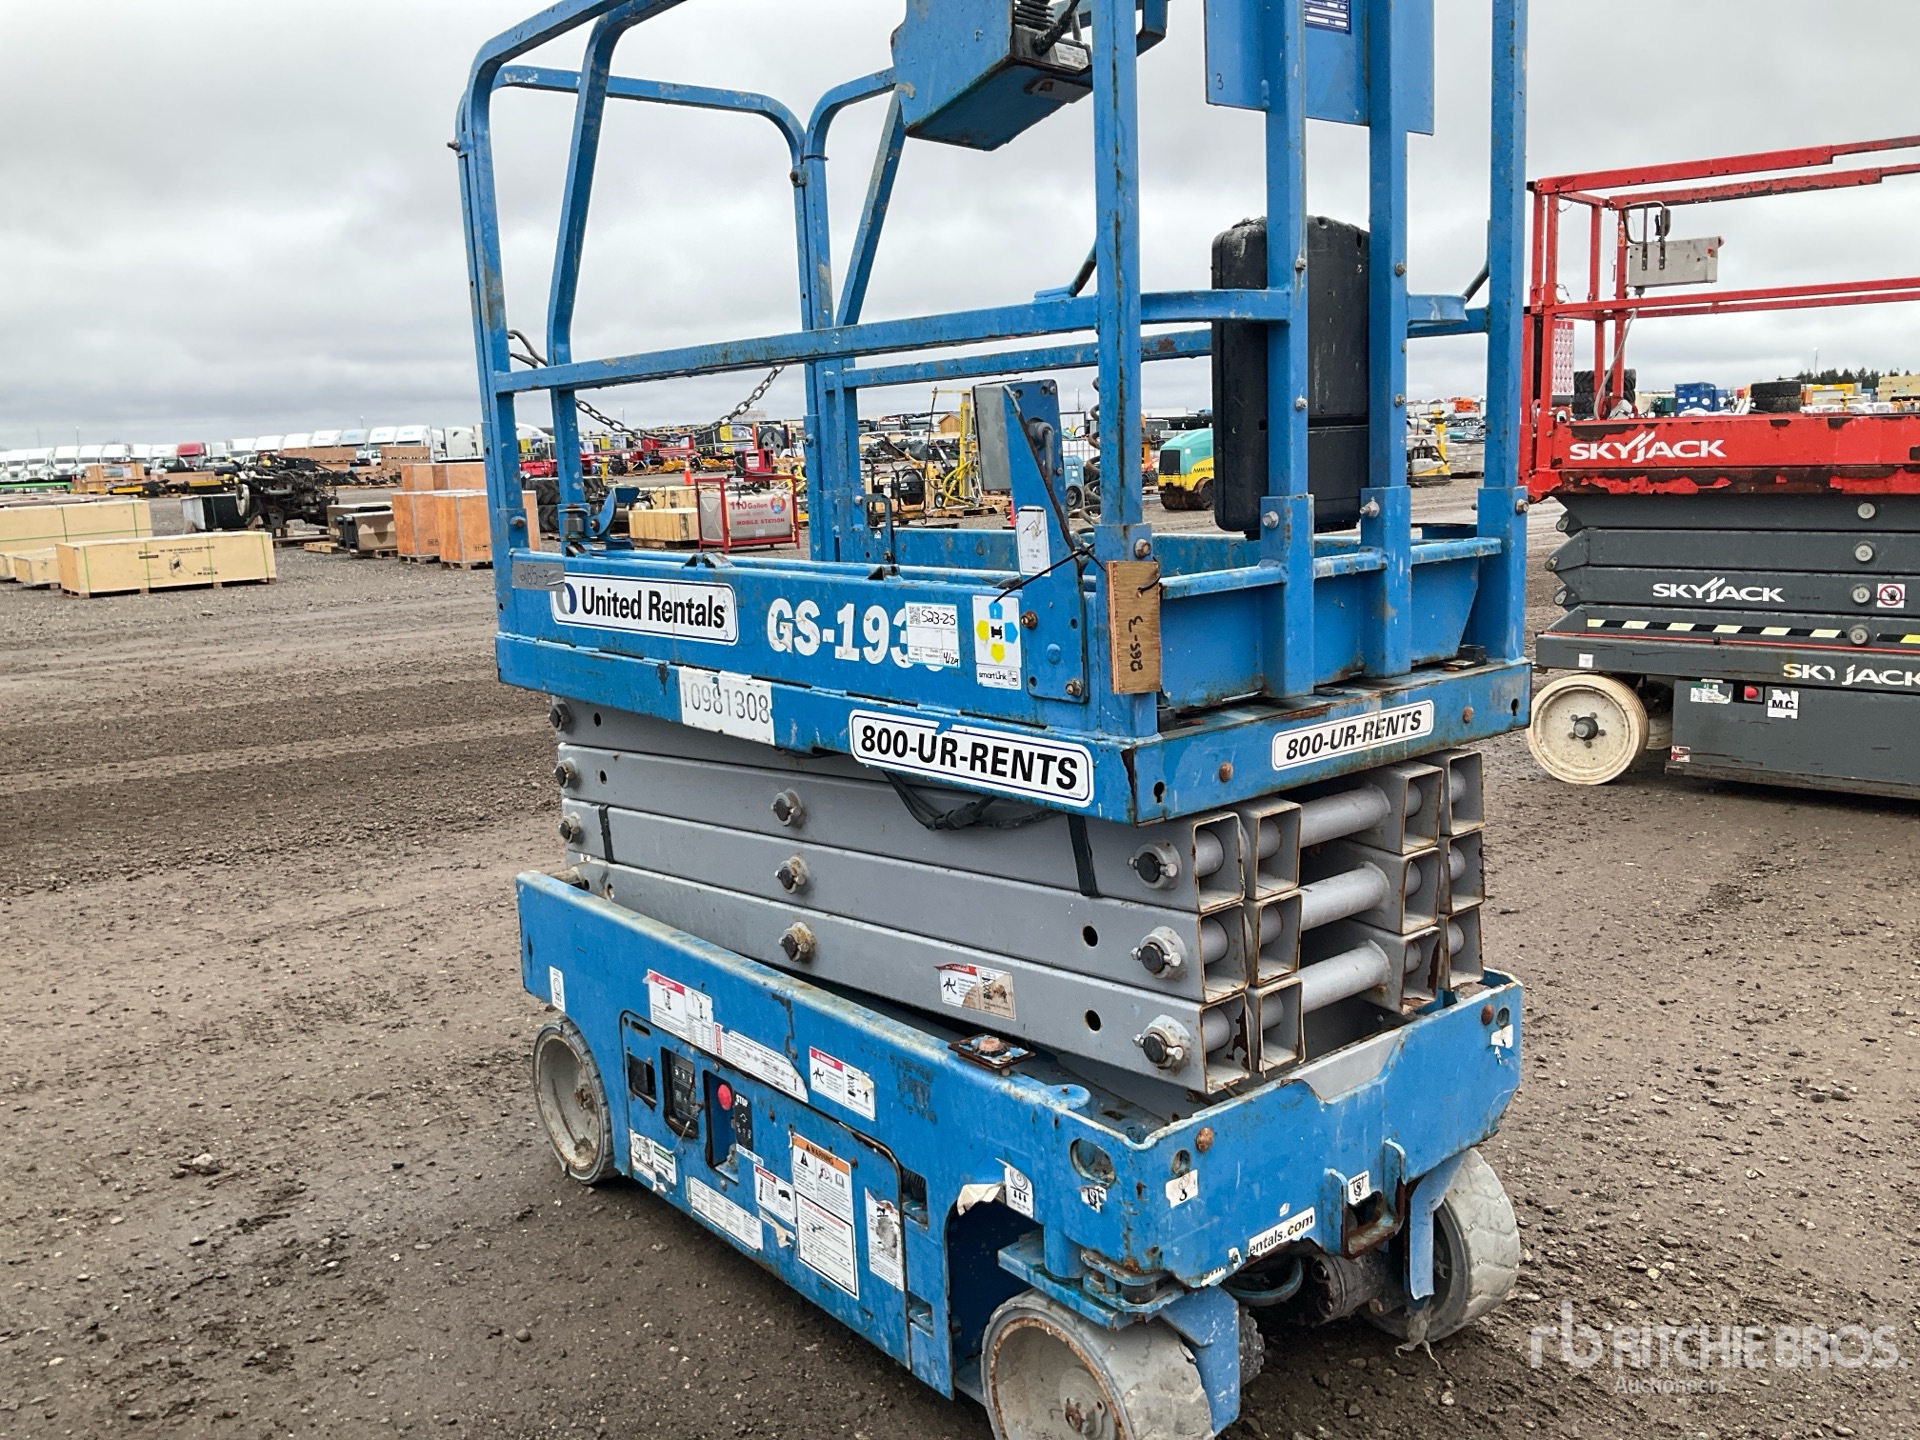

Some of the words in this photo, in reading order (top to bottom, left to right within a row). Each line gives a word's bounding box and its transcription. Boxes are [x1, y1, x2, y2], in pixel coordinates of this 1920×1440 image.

[1216, 72, 1224, 90] 3
[1569, 430, 1727, 464] SKYJACK
[748, 501, 768, 510] Gallon
[736, 518, 758, 526] MOBILE
[760, 517, 785, 525] STATION
[1652, 576, 1785, 603] SKYJACK
[581, 585, 642, 620] United
[648, 590, 726, 629] Rentals
[1128, 615, 1144, 672] 265-3
[681, 681, 770, 724] 10981308
[1285, 708, 1423, 761] 800-UR-RENTS
[860, 724, 1079, 791] 800-UR-RENTS
[734, 1093, 749, 1108] STOP
[809, 1143, 834, 1166] WARNING
